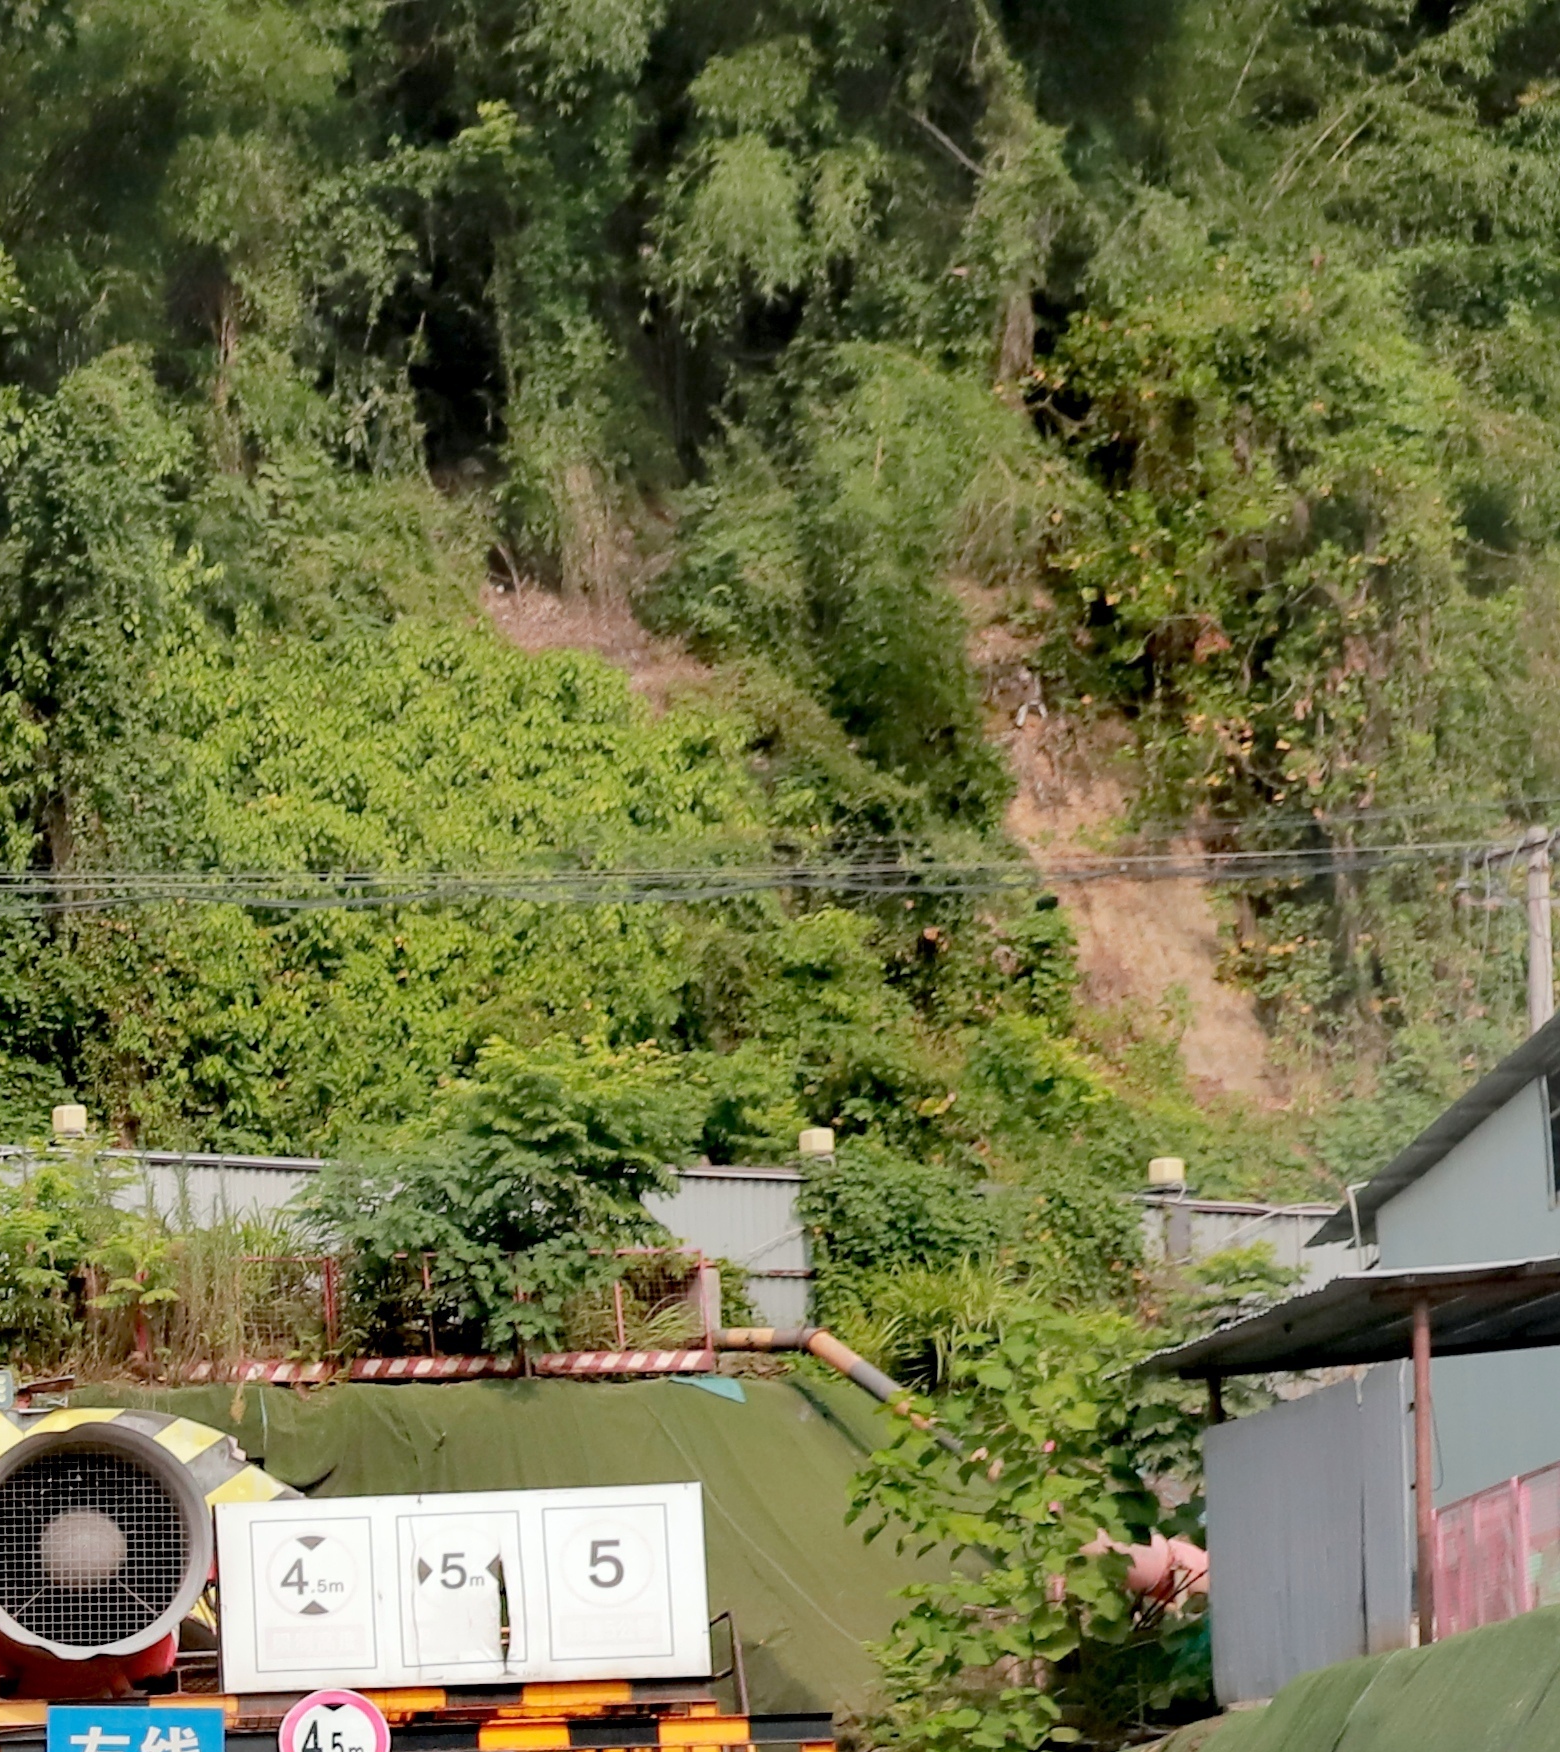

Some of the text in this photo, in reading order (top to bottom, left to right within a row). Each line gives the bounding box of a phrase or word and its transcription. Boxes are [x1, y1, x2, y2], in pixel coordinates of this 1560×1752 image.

[280, 1557, 345, 1596] 4.5m
[439, 1552, 486, 1590] 5m
[588, 1539, 626, 1588] 5
